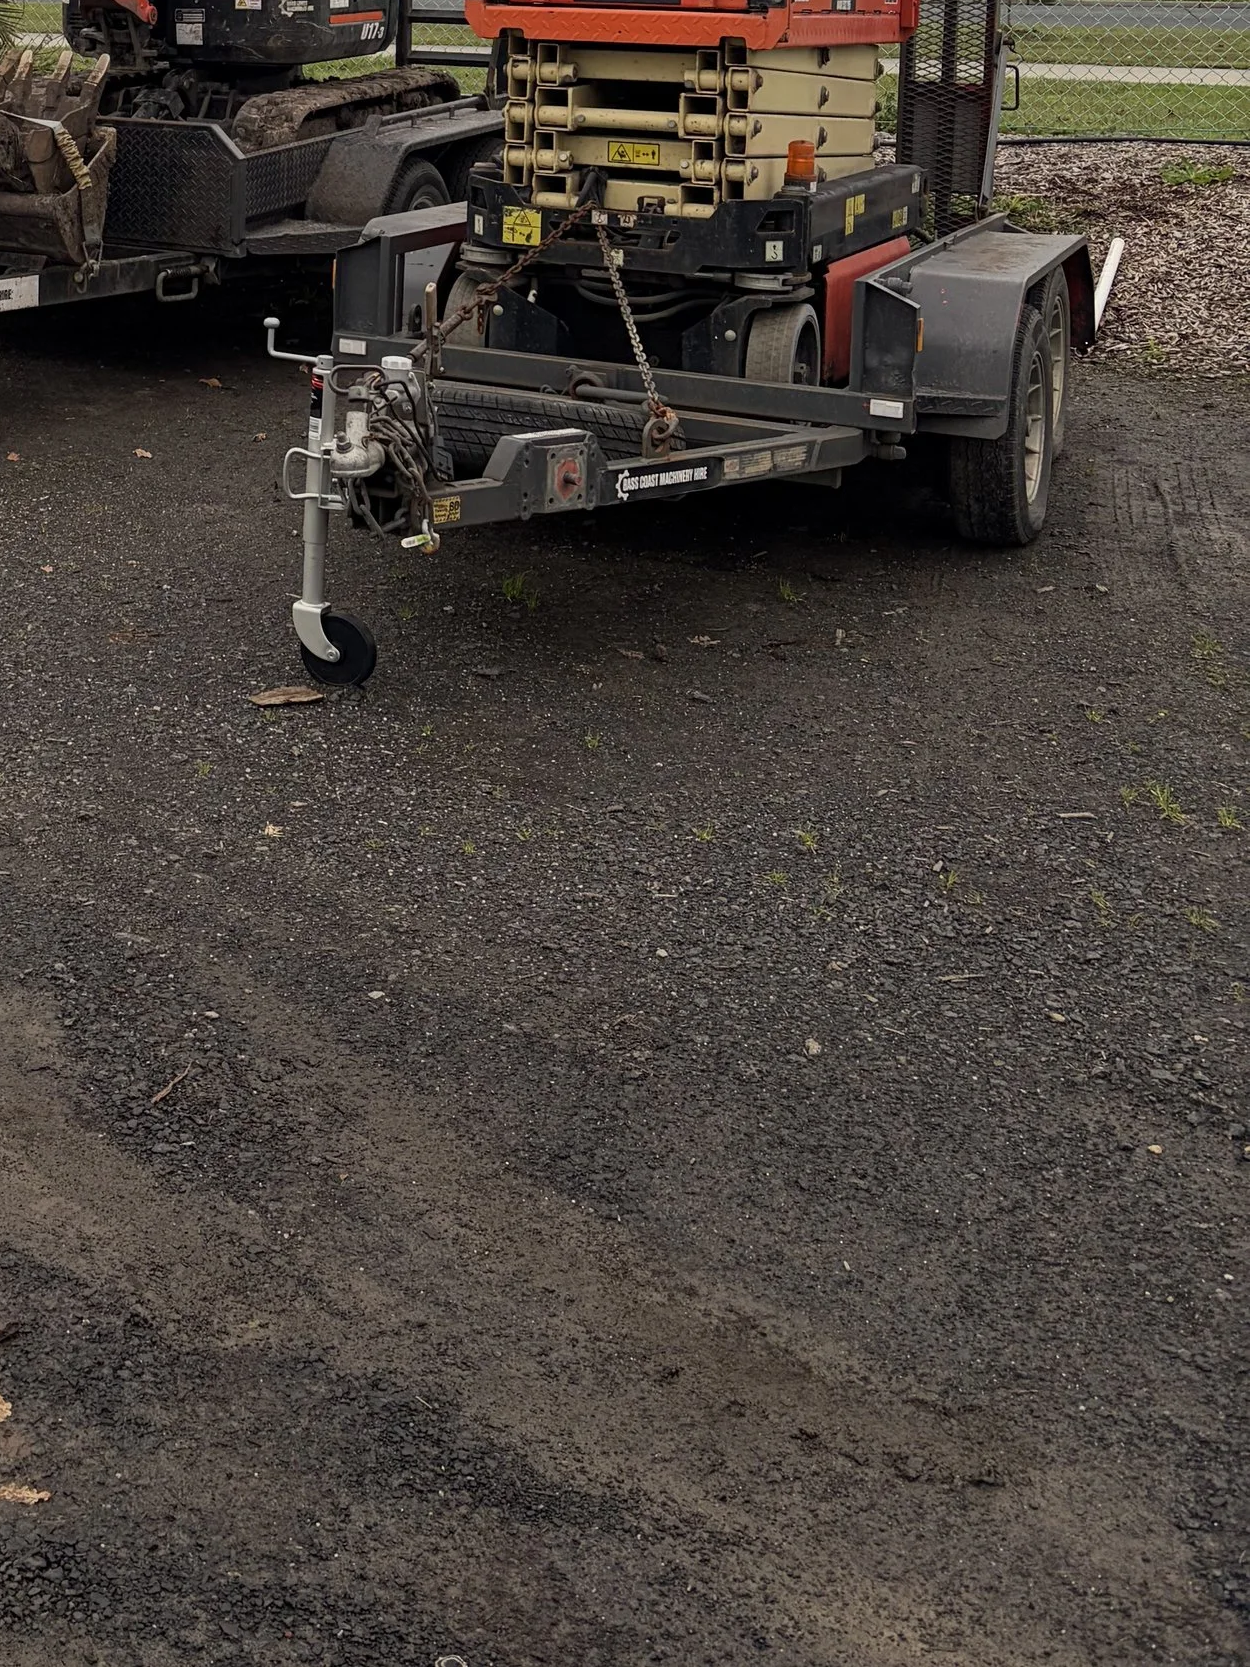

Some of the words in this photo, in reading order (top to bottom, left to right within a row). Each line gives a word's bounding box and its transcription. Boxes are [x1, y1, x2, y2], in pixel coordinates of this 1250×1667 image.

[623, 478, 638, 492] BASS
[639, 474, 659, 489] COAST
[660, 470, 692, 487] MACHINERY
[693, 466, 708, 481] HIRE
